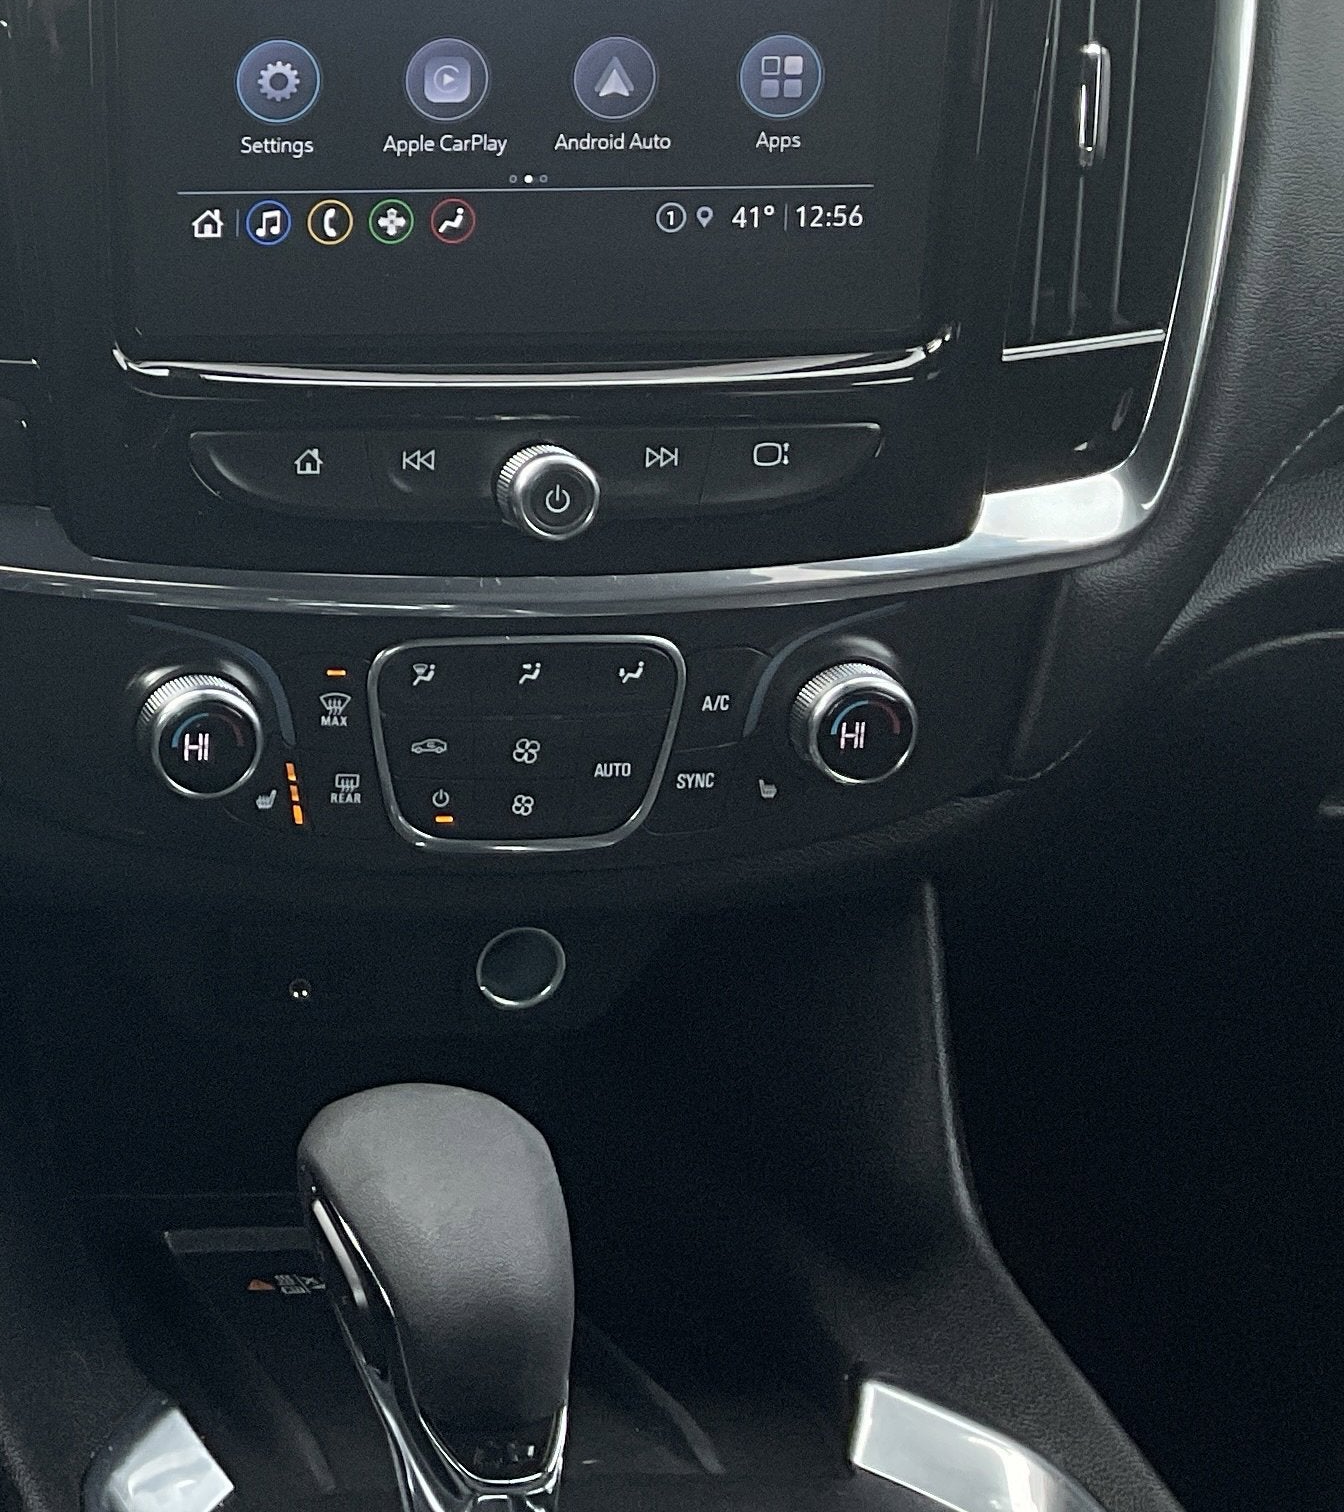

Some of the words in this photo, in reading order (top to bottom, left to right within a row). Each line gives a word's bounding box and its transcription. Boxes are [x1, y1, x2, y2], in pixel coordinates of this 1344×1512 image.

[240, 136, 314, 158] Settings
[383, 135, 435, 156] Apple
[439, 134, 508, 156] CarPlay
[554, 133, 624, 150] Android
[628, 133, 672, 150] Auto
[755, 131, 801, 151] Apps
[731, 205, 775, 228] 41°
[795, 205, 864, 228] 12:56
[702, 694, 730, 712] A/C
[320, 716, 348, 727] MAX
[840, 721, 866, 749] HI
[183, 732, 210, 762] HI
[594, 762, 632, 778] AUTO
[676, 772, 715, 789] SYNC
[330, 792, 361, 804] REAR
